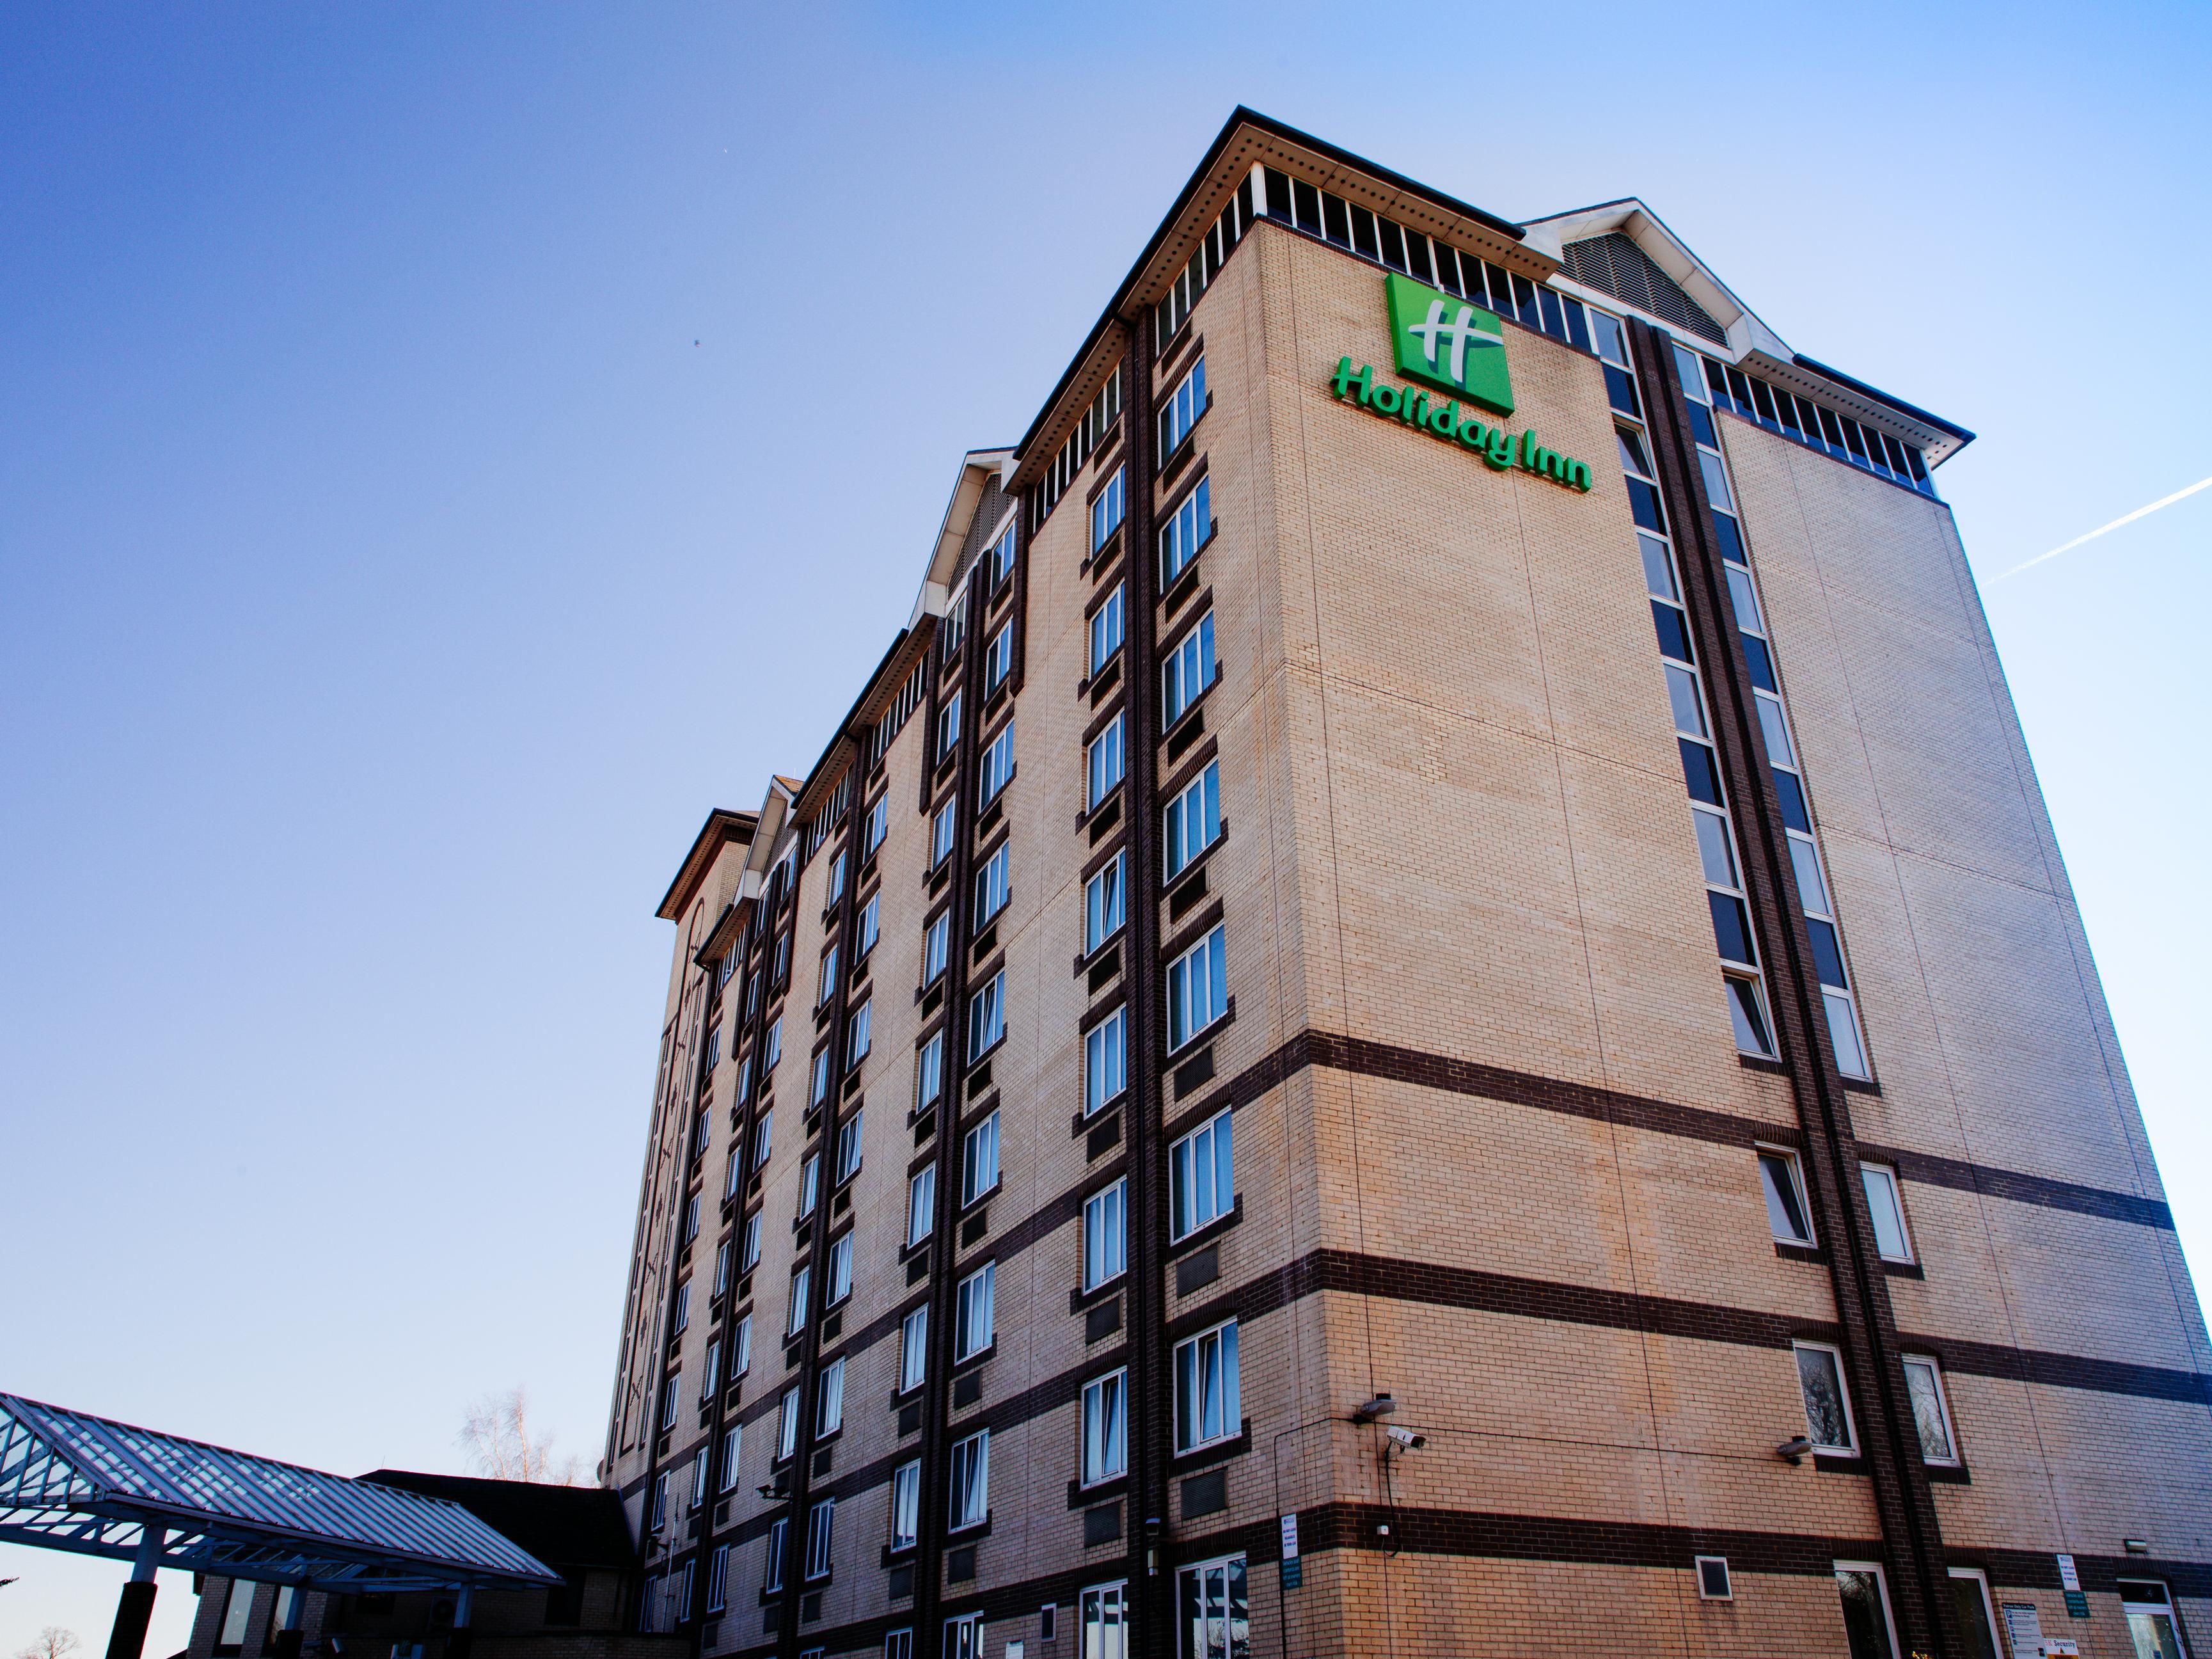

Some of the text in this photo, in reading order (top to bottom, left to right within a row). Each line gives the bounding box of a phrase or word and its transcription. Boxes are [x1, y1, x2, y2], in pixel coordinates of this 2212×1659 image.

[1330, 356, 1592, 493] Holiday Inn
[2053, 1639, 2075, 1648] Security
